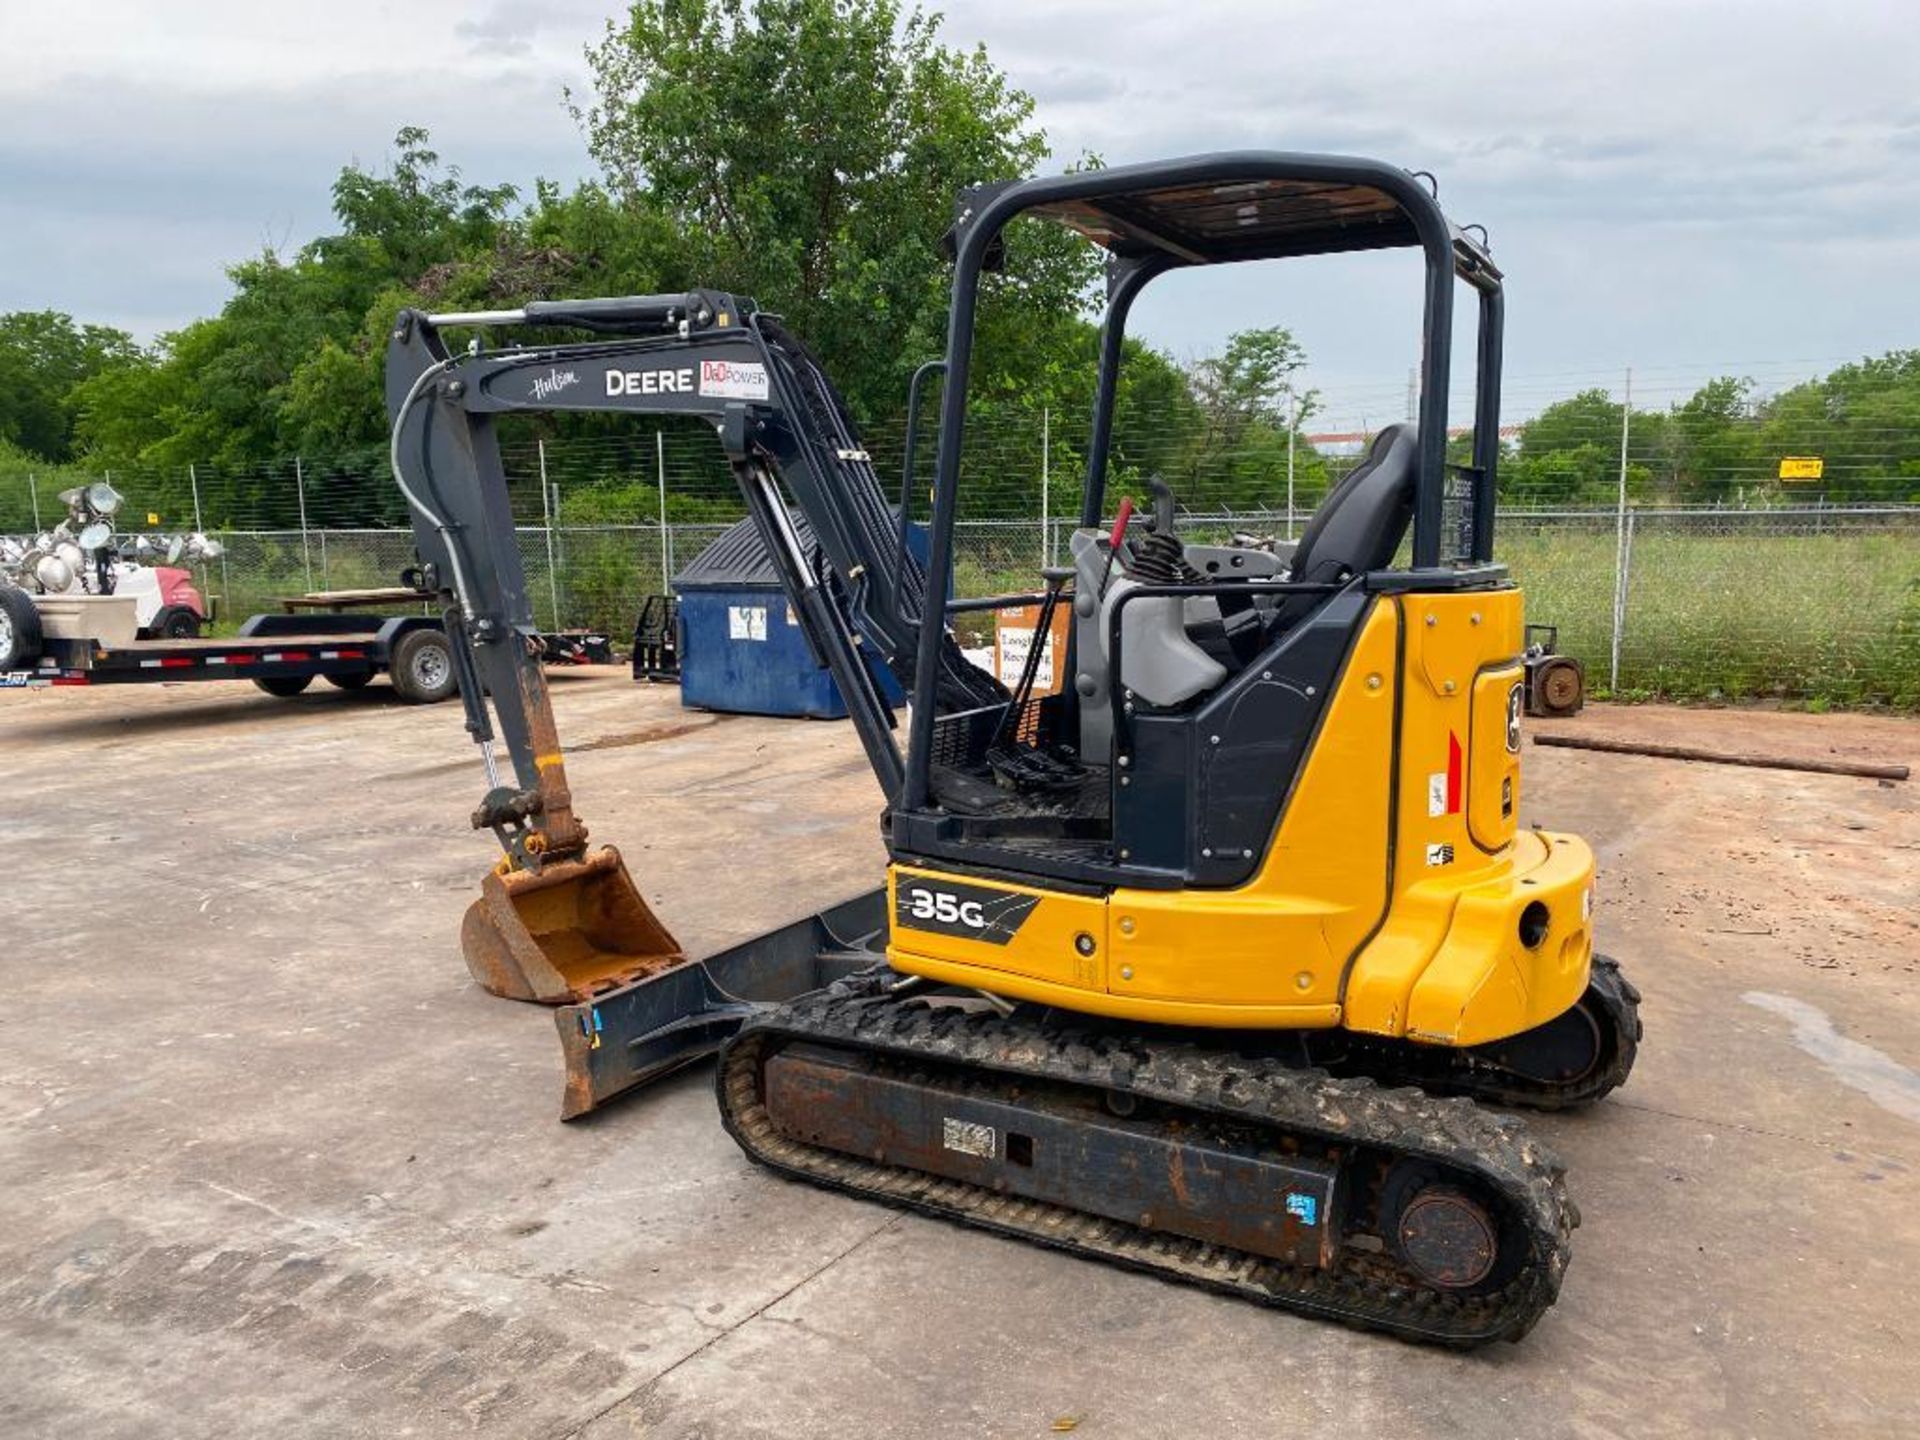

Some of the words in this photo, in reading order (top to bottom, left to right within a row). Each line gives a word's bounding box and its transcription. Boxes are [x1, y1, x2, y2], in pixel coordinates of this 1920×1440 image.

[606, 368, 693, 396] DEERE
[726, 369, 765, 385] POWER
[911, 888, 984, 928] 35G
